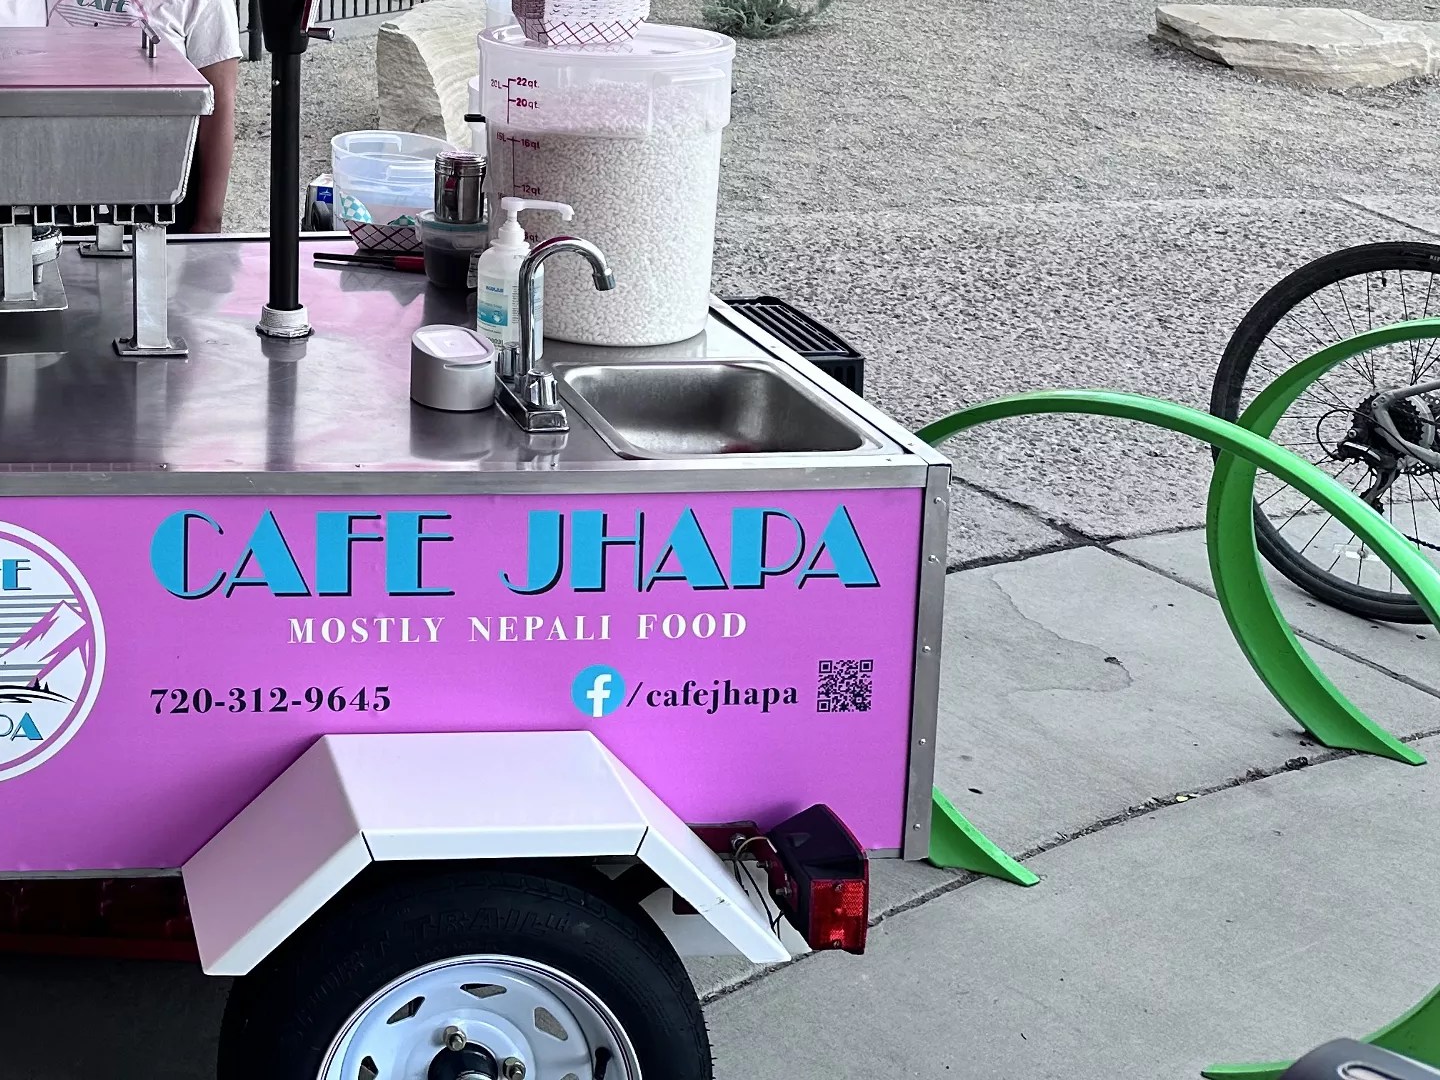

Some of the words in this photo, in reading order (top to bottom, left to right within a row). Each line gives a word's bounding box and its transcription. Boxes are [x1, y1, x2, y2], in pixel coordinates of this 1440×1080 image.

[150, 510, 456, 600] CAFE
[500, 505, 881, 597] JHAPA
[287, 617, 445, 645] MOSTLY
[468, 614, 611, 642] NEPALI
[636, 612, 748, 640] FOOD
[150, 686, 392, 715] 720-312-9645
